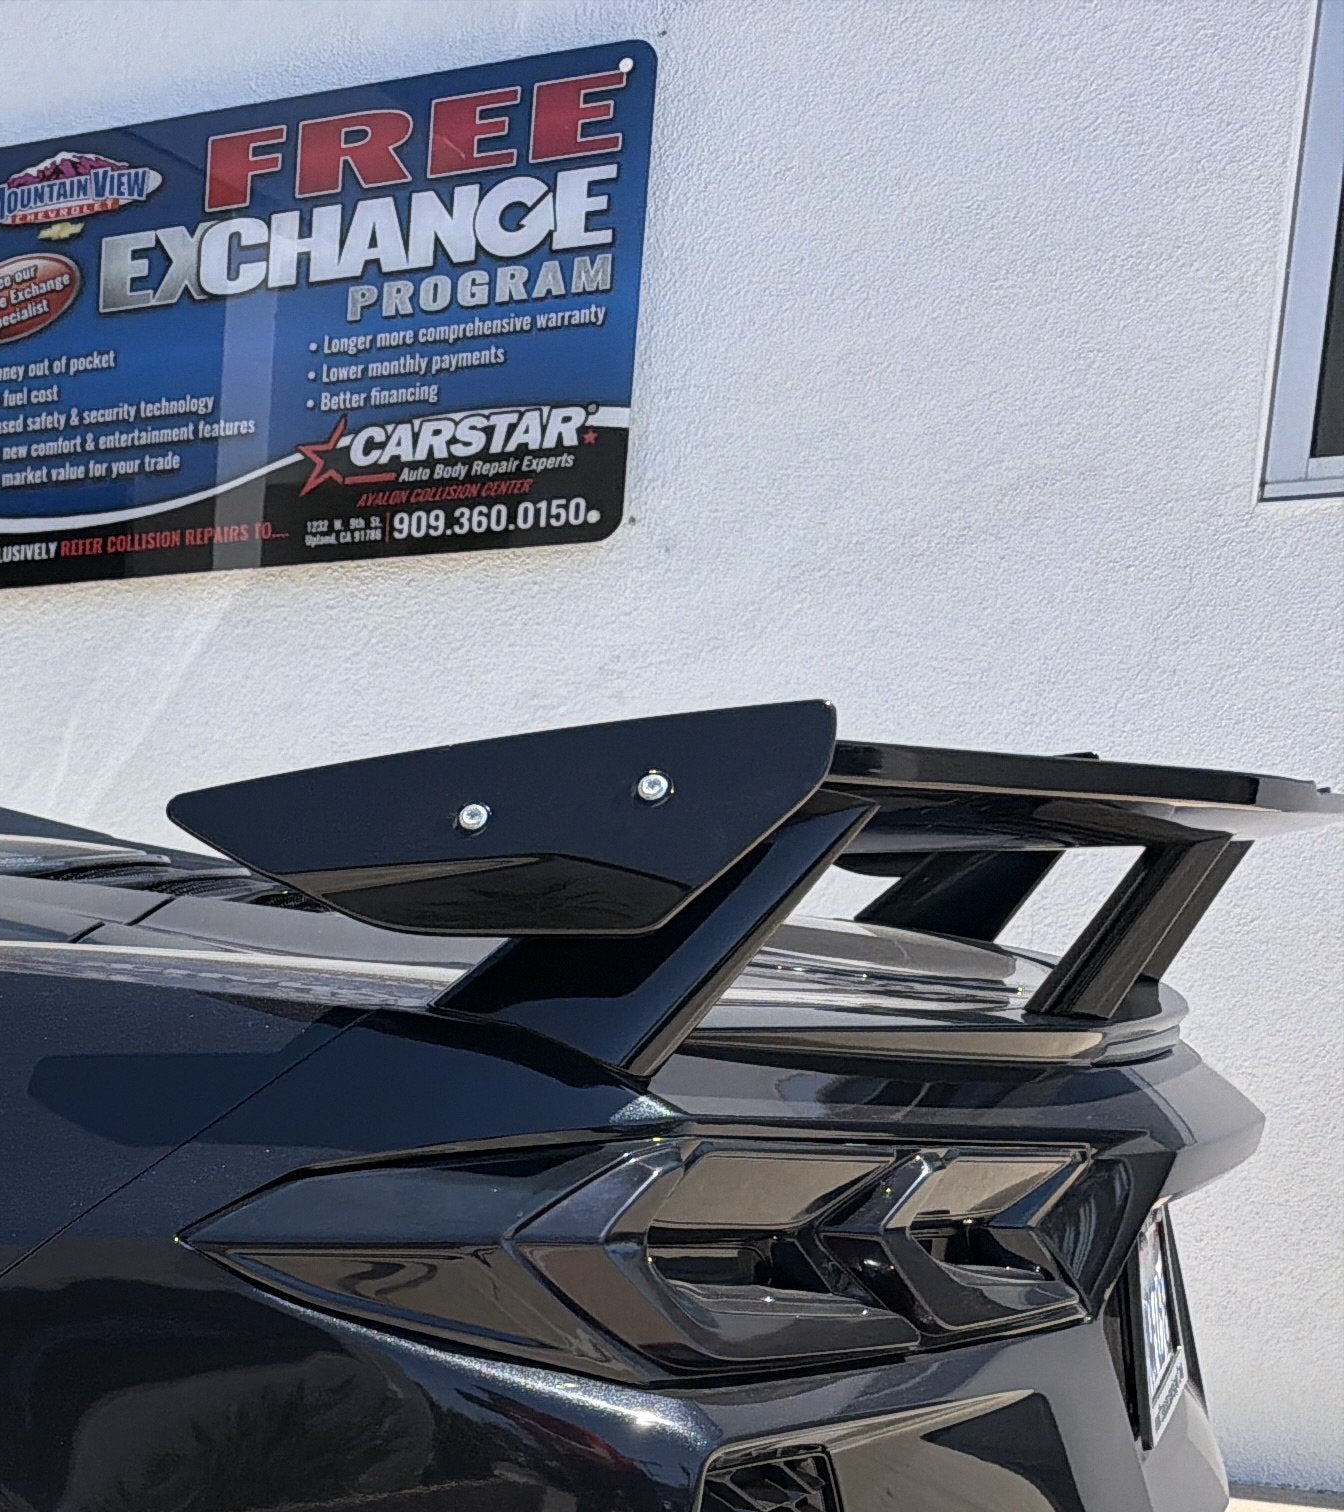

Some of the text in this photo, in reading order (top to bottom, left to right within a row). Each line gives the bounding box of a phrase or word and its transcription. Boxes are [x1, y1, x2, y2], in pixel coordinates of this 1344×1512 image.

[204, 70, 628, 213] FREE
[91, 167, 149, 200] VIEW
[15, 202, 113, 223] CHEVROLET
[99, 164, 618, 313] EXCHANGE
[10, 274, 70, 304] Exchange
[15, 265, 38, 282] our
[347, 253, 613, 322] PROGRAM
[324, 304, 605, 354] Longer more comprehensive warranty
[28, 358, 49, 376] out
[53, 356, 67, 374] of
[70, 350, 115, 375] pocket
[322, 345, 505, 383] Lower monthly payments
[3, 386, 27, 407] fuel
[31, 385, 58, 403] cost
[27, 411, 66, 430] safety
[70, 408, 79, 425] &
[83, 403, 136, 424] security
[140, 394, 214, 418] technology
[320, 382, 438, 411] Better financing
[3, 444, 28, 460] new
[31, 435, 81, 457] comfort
[85, 432, 95, 450] &
[99, 422, 194, 449] entertainment
[199, 419, 255, 438] features
[349, 407, 587, 466] CARSTAR
[2, 466, 47, 485] market
[51, 462, 85, 481] value
[89, 460, 107, 477] for
[112, 459, 140, 478] your
[145, 451, 180, 471] trade
[398, 452, 575, 483] Auto Body Repair Experts
[356, 478, 534, 508] AVALON COLLISION CENTER
[393, 498, 587, 540] 909.360.0150
[60, 539, 102, 557] REFER
[107, 532, 180, 554] COLLISION
[185, 523, 249, 545] REPAIRS
[340, 531, 352, 543] CA
